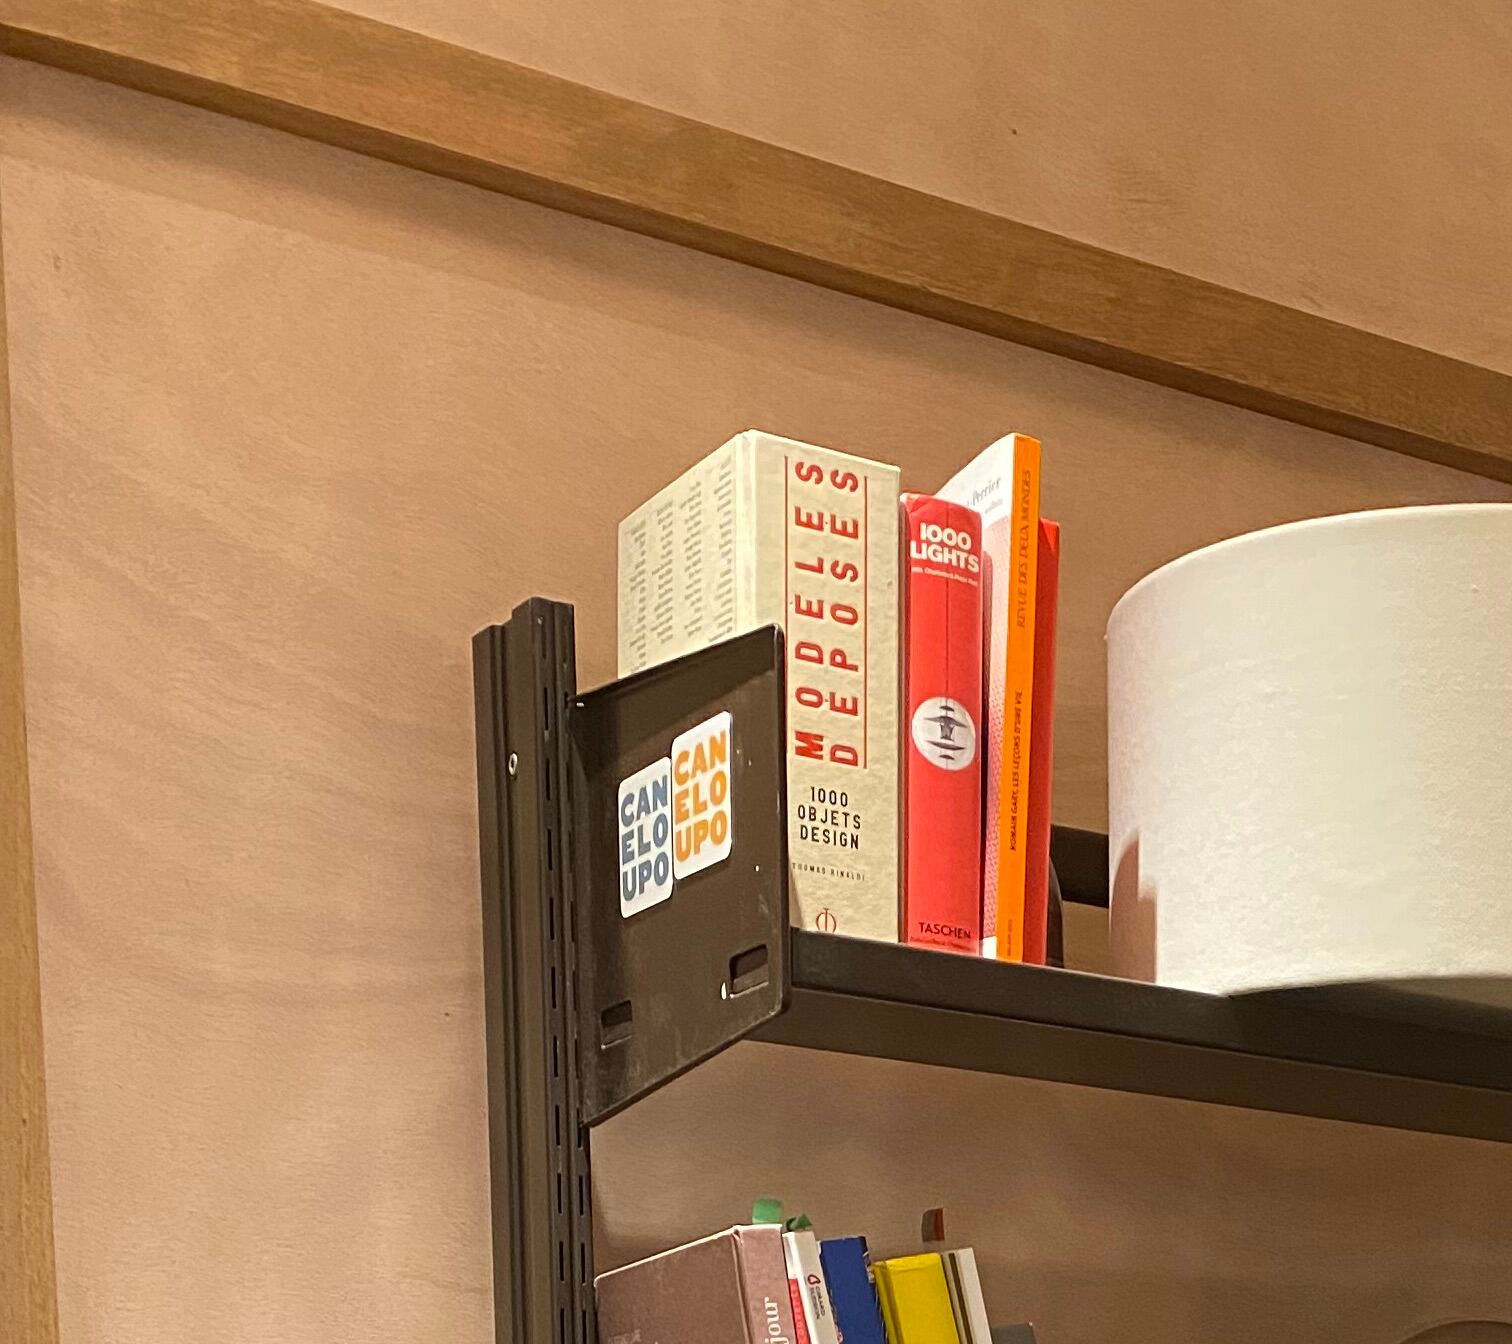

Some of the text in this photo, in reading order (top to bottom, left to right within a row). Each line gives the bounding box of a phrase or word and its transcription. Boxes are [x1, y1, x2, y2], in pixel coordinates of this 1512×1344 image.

[919, 522, 973, 551] 1000
[910, 540, 980, 574] LIGHTS
[1018, 561, 1029, 584] DES
[674, 730, 727, 786] CAN
[620, 774, 669, 828] CAN
[674, 770, 728, 826] ELO
[810, 786, 849, 807] 1000
[797, 804, 862, 830] OBJETS
[621, 812, 669, 866] ELO
[675, 810, 728, 863] UPO
[800, 825, 860, 850] DESIGN
[622, 850, 670, 902] UPO
[918, 921, 972, 940] TASCHEN
